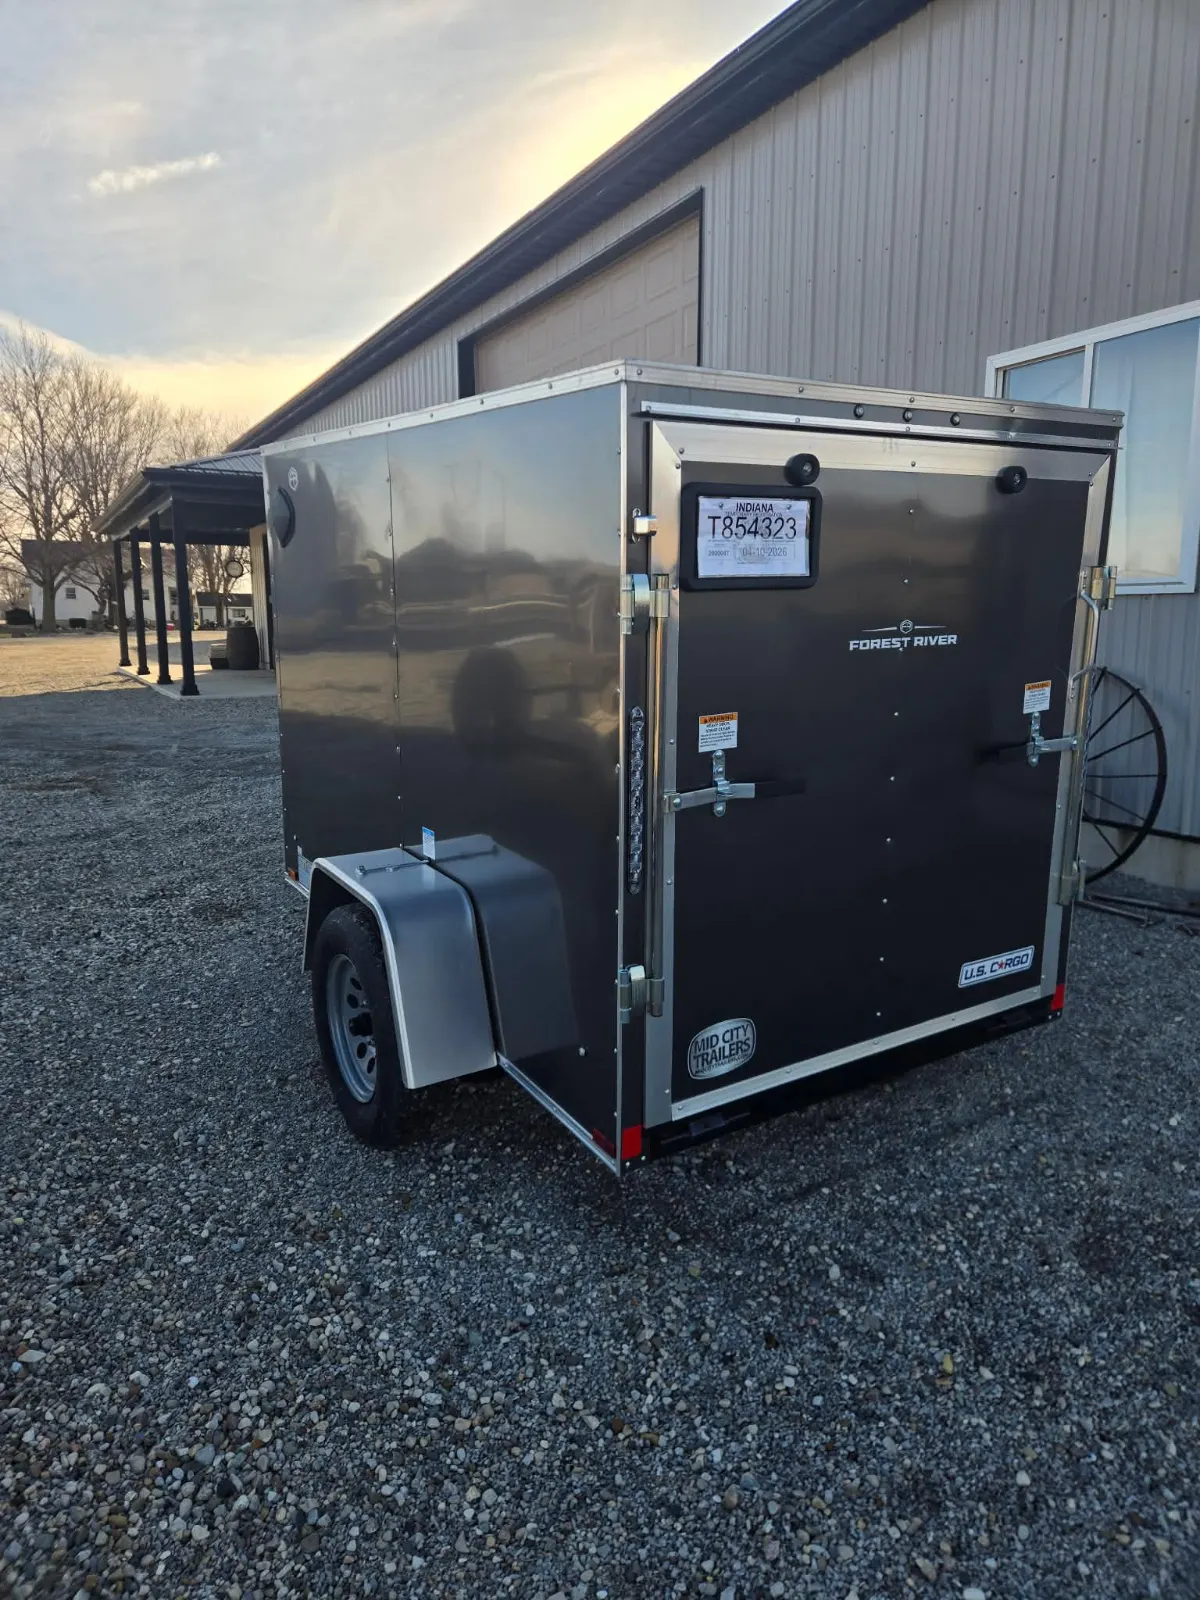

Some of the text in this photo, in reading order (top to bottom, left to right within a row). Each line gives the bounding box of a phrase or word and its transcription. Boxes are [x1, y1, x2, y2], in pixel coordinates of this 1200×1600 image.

[736, 502, 774, 512] INDIANA
[708, 516, 797, 539] T854323
[742, 547, 788, 557] 04-10-2026
[849, 634, 958, 651] FOREST RIVER
[708, 713, 734, 722] WARNING
[965, 965, 987, 980] U.S.
[694, 1023, 749, 1054] MID CITY
[693, 1037, 751, 1069] TRAILERS
